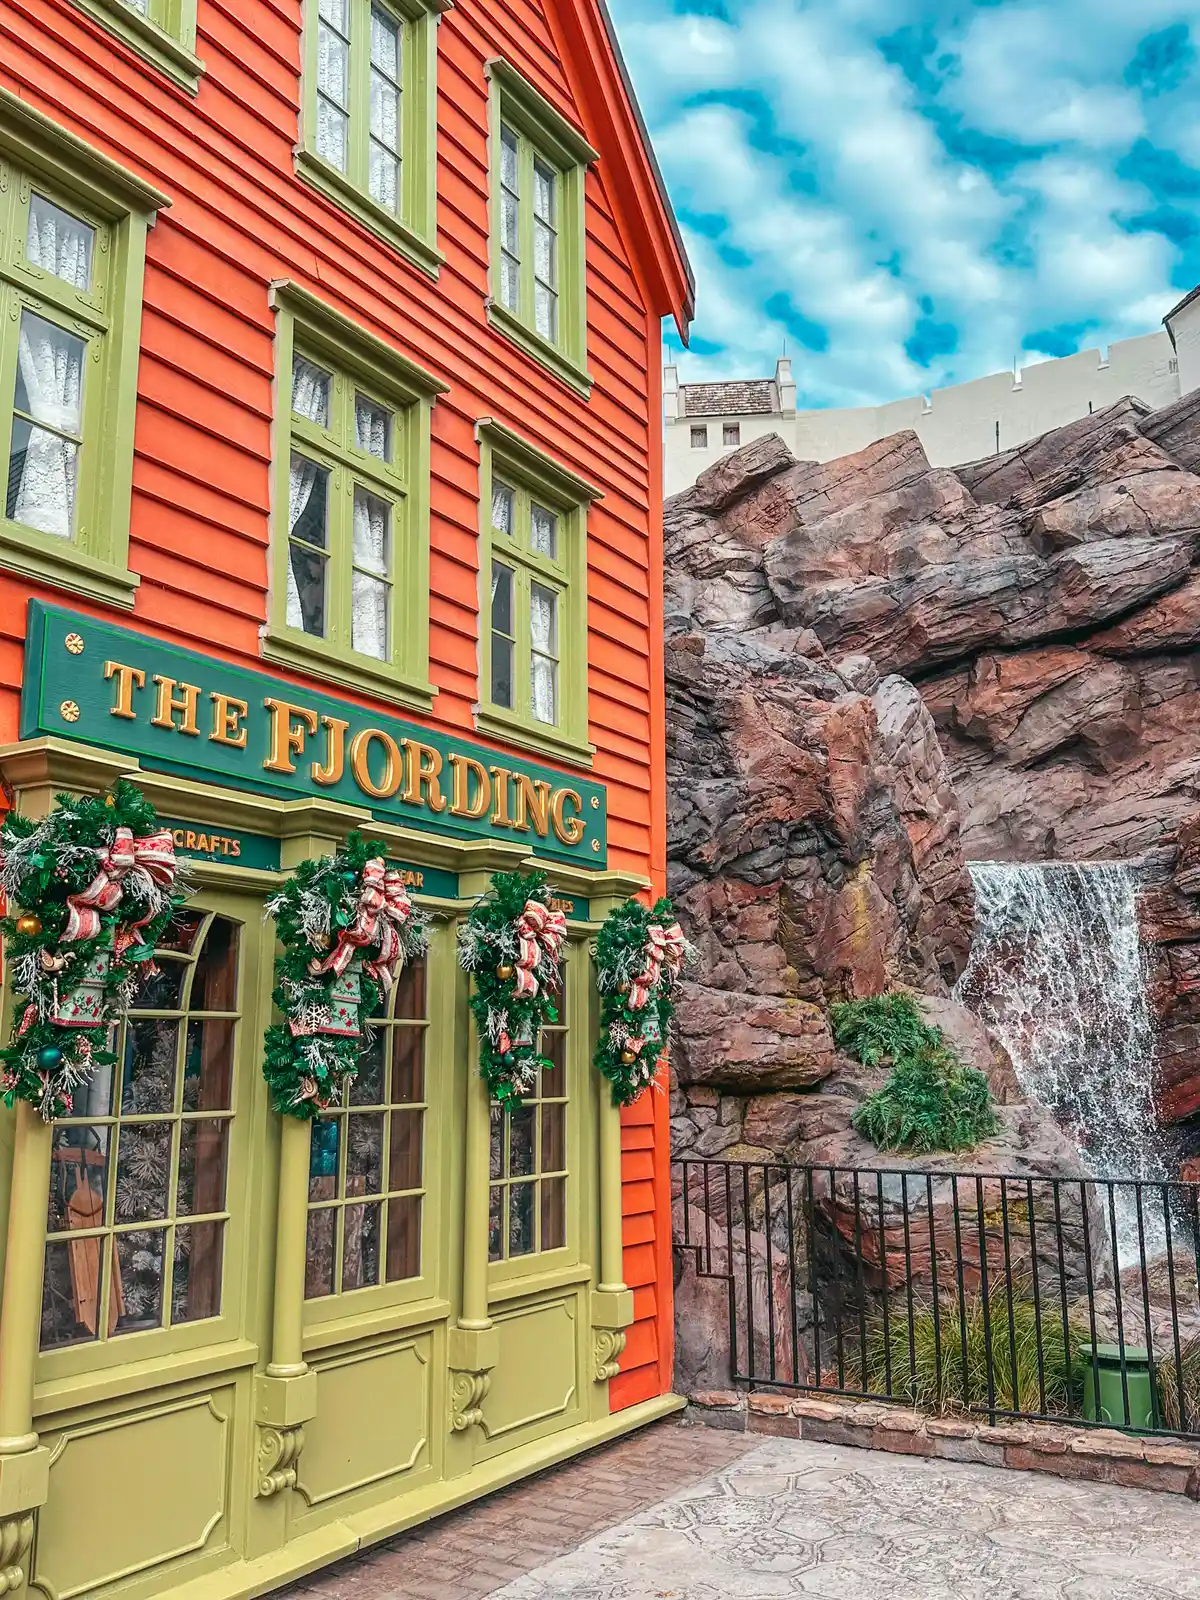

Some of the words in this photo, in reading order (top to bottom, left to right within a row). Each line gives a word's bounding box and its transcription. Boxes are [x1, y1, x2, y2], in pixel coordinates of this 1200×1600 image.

[103, 660, 249, 748] THE
[263, 697, 587, 846] FJORDING
[160, 827, 241, 857] CRAFTS
